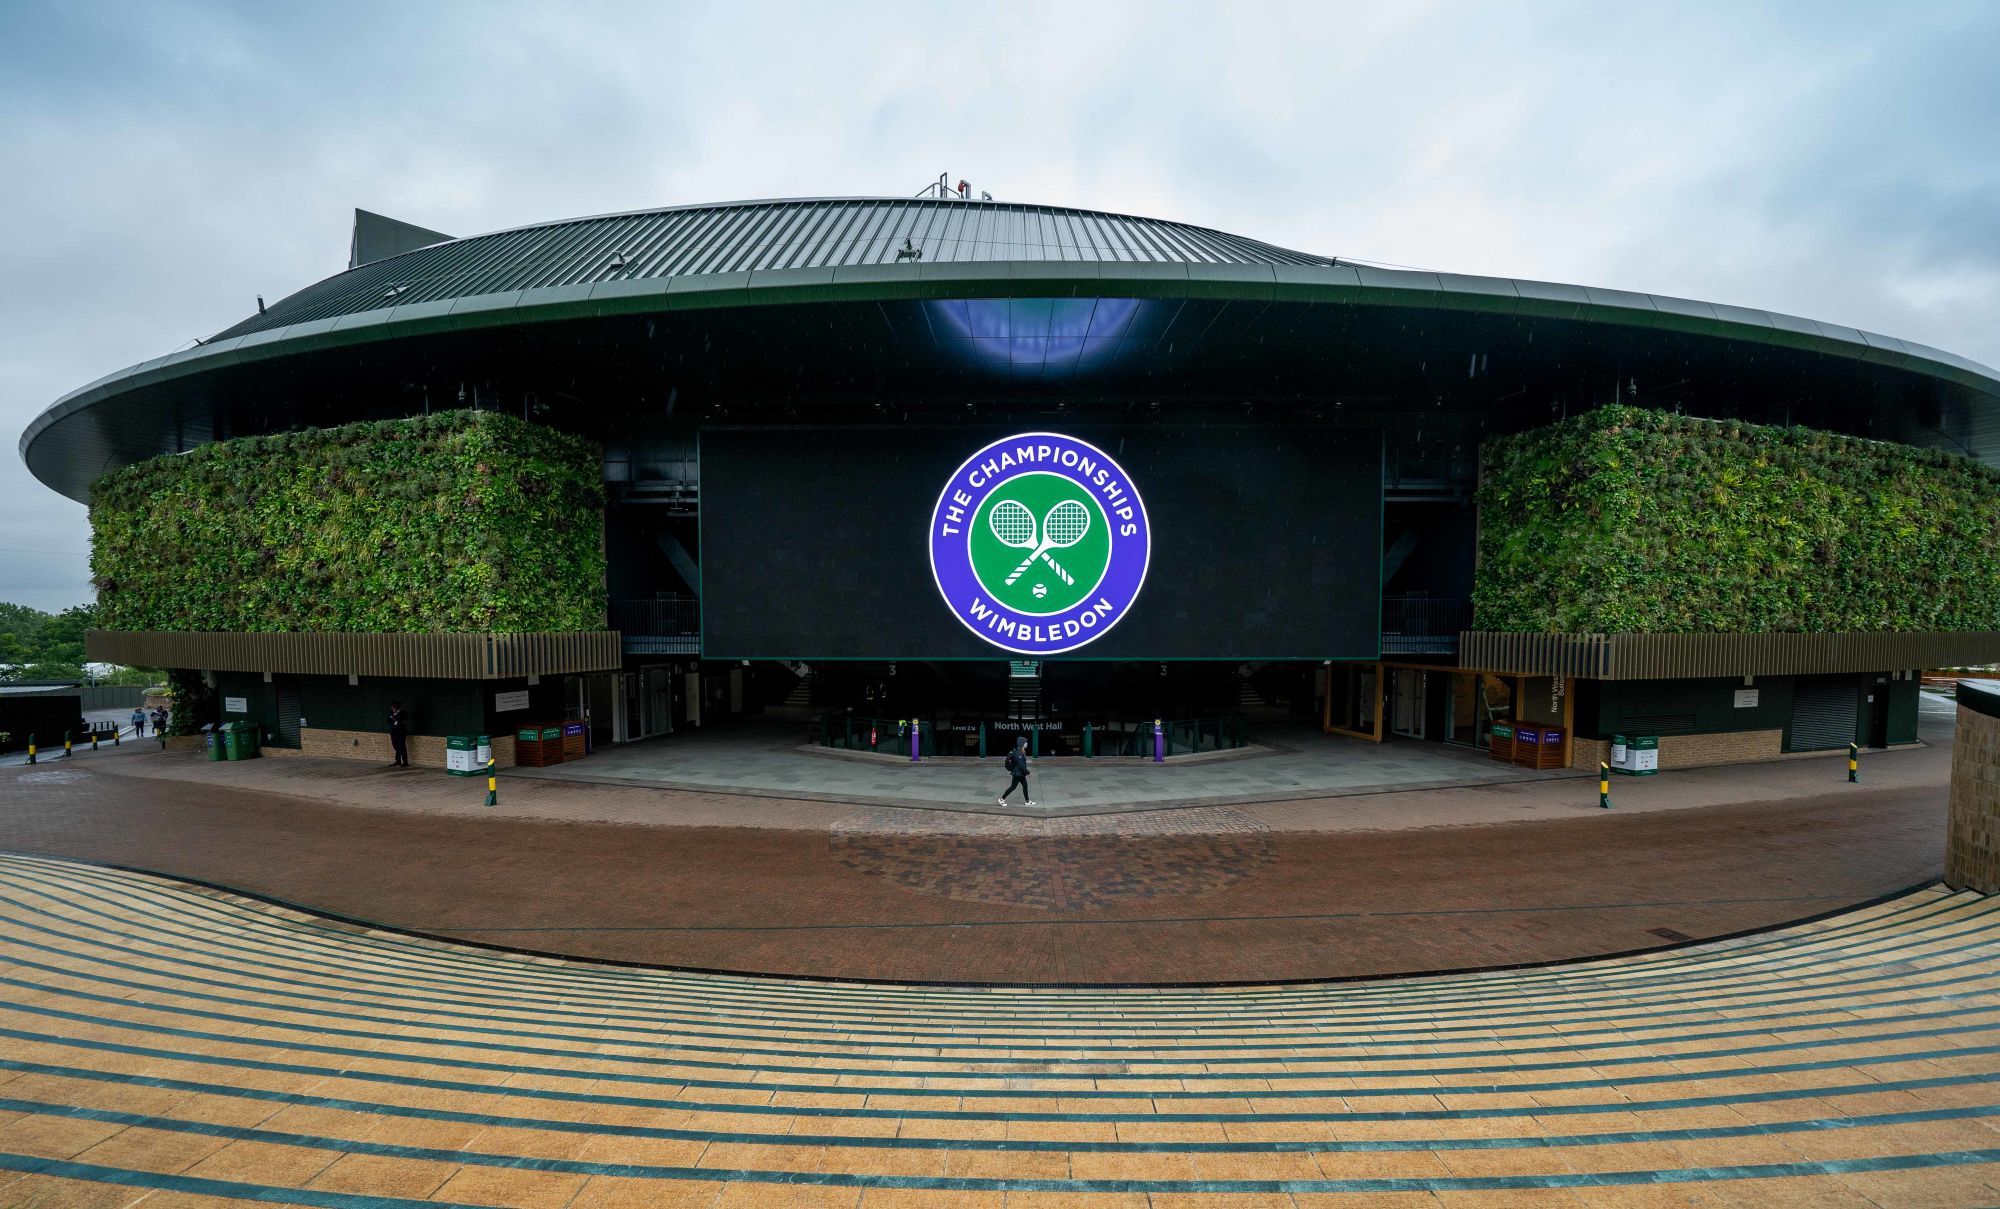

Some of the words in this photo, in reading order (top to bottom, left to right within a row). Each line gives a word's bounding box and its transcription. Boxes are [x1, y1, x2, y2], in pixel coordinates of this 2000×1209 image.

[943, 489, 972, 537] THE
[968, 445, 1137, 537] CHAMPIONSHIPS
[969, 597, 1114, 642] WIMBLEDON
[889, 664, 897, 676] 3
[1160, 664, 1168, 676] 3
[994, 721, 1020, 731] North
[1045, 721, 1063, 730] Hall
